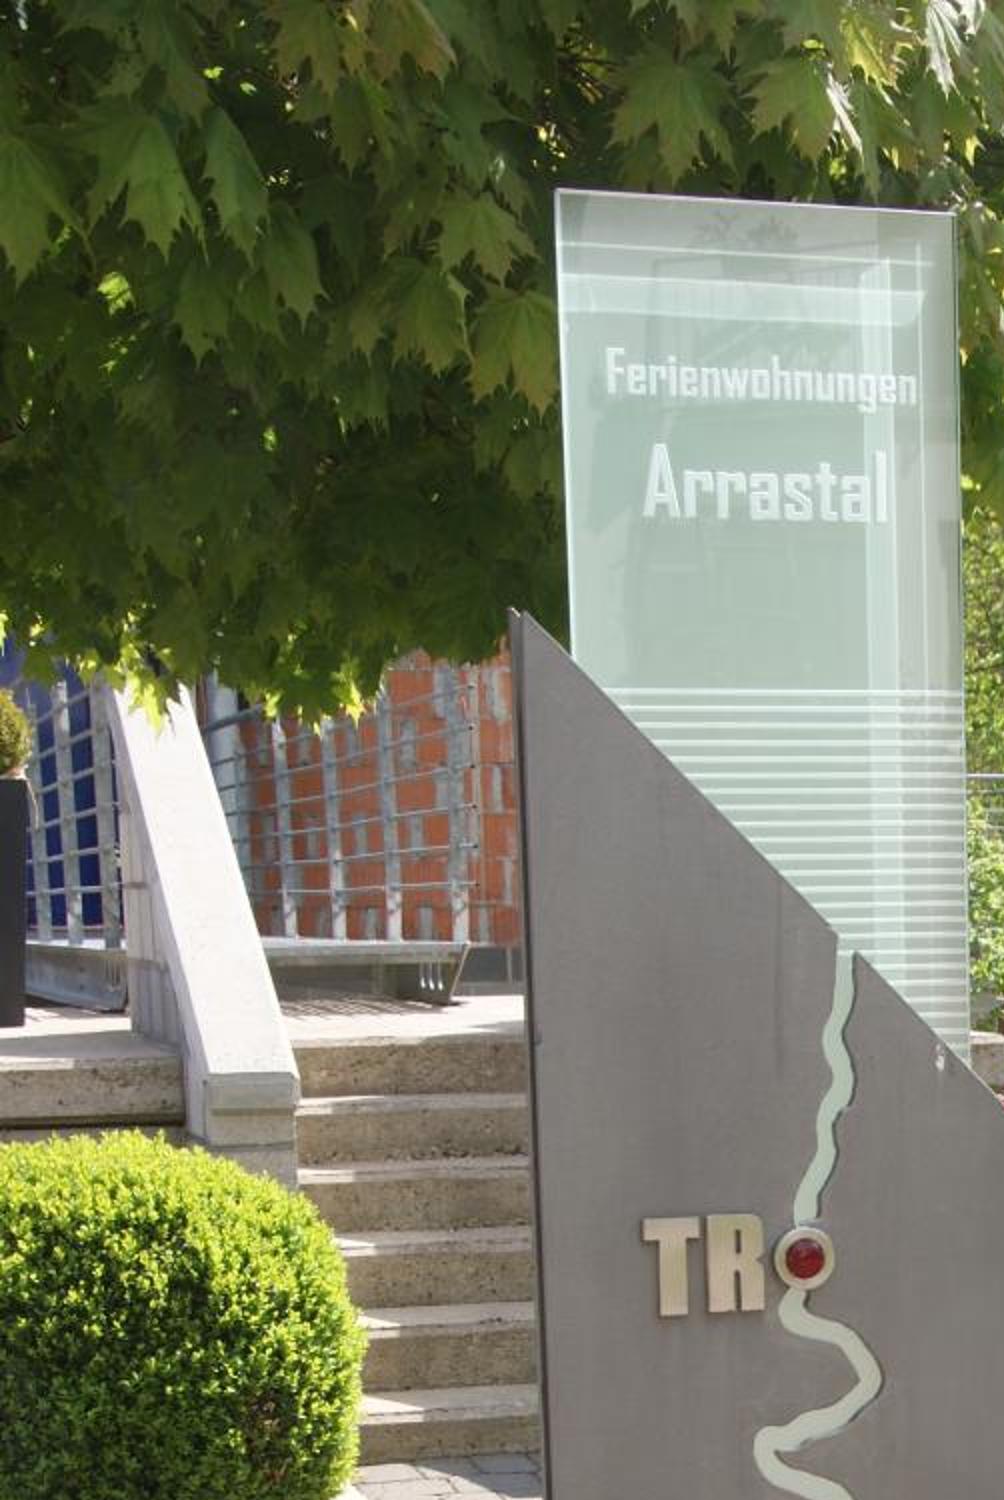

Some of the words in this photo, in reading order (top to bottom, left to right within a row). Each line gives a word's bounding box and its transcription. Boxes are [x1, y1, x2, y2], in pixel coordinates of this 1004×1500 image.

[605, 347, 918, 414] Ferienwohnungen
[642, 442, 889, 524] Arrastal
[642, 1213, 765, 1316] TR
